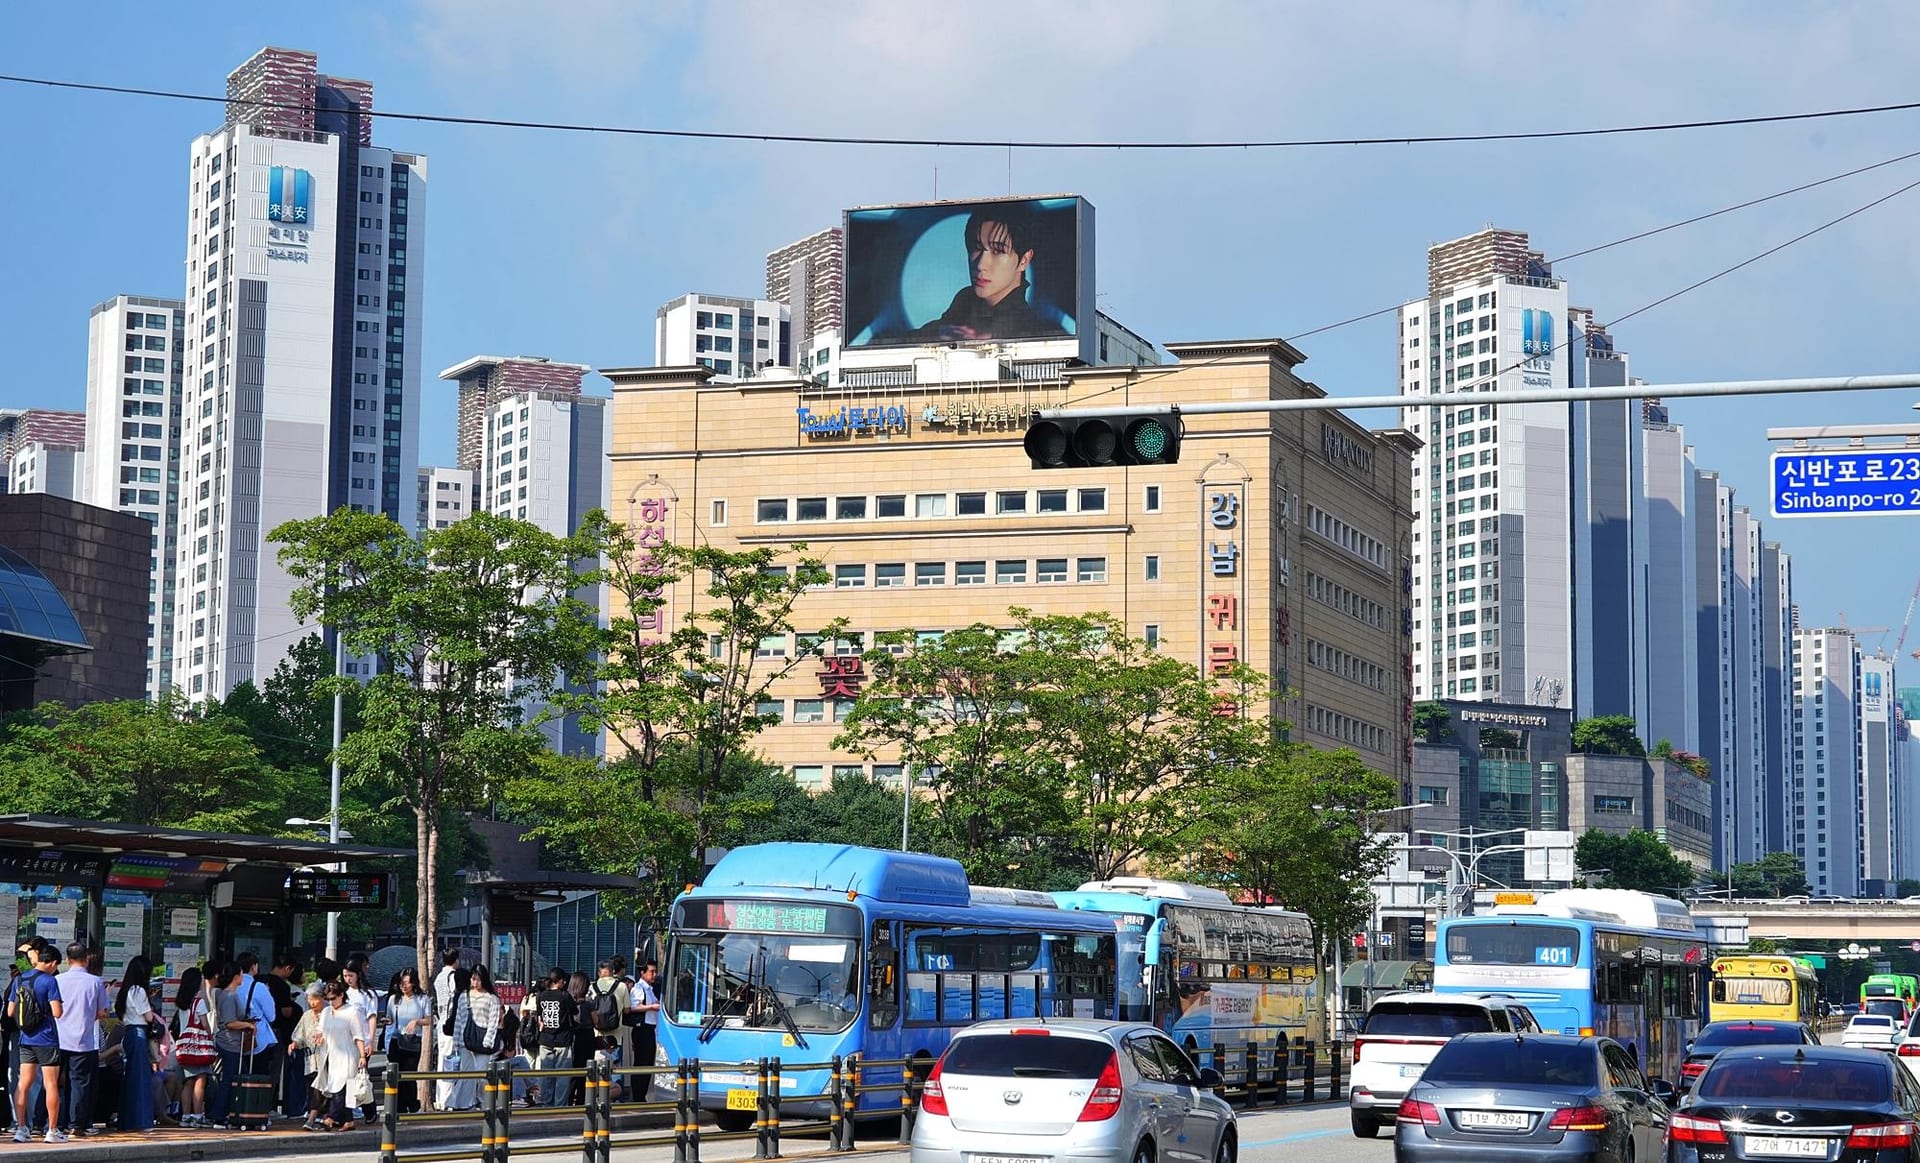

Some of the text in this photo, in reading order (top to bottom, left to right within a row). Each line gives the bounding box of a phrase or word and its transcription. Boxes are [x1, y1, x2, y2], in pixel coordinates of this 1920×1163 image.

[849, 404, 905, 429] 토다이
[1781, 491, 1905, 511] Sinbanpo-ro
[1209, 492, 1238, 576] 강남
[1540, 947, 1567, 963] 401
[540, 1000, 560, 1011] YES
[1494, 1113, 1522, 1125] 7394
[1785, 1140, 1820, 1153] 7147
